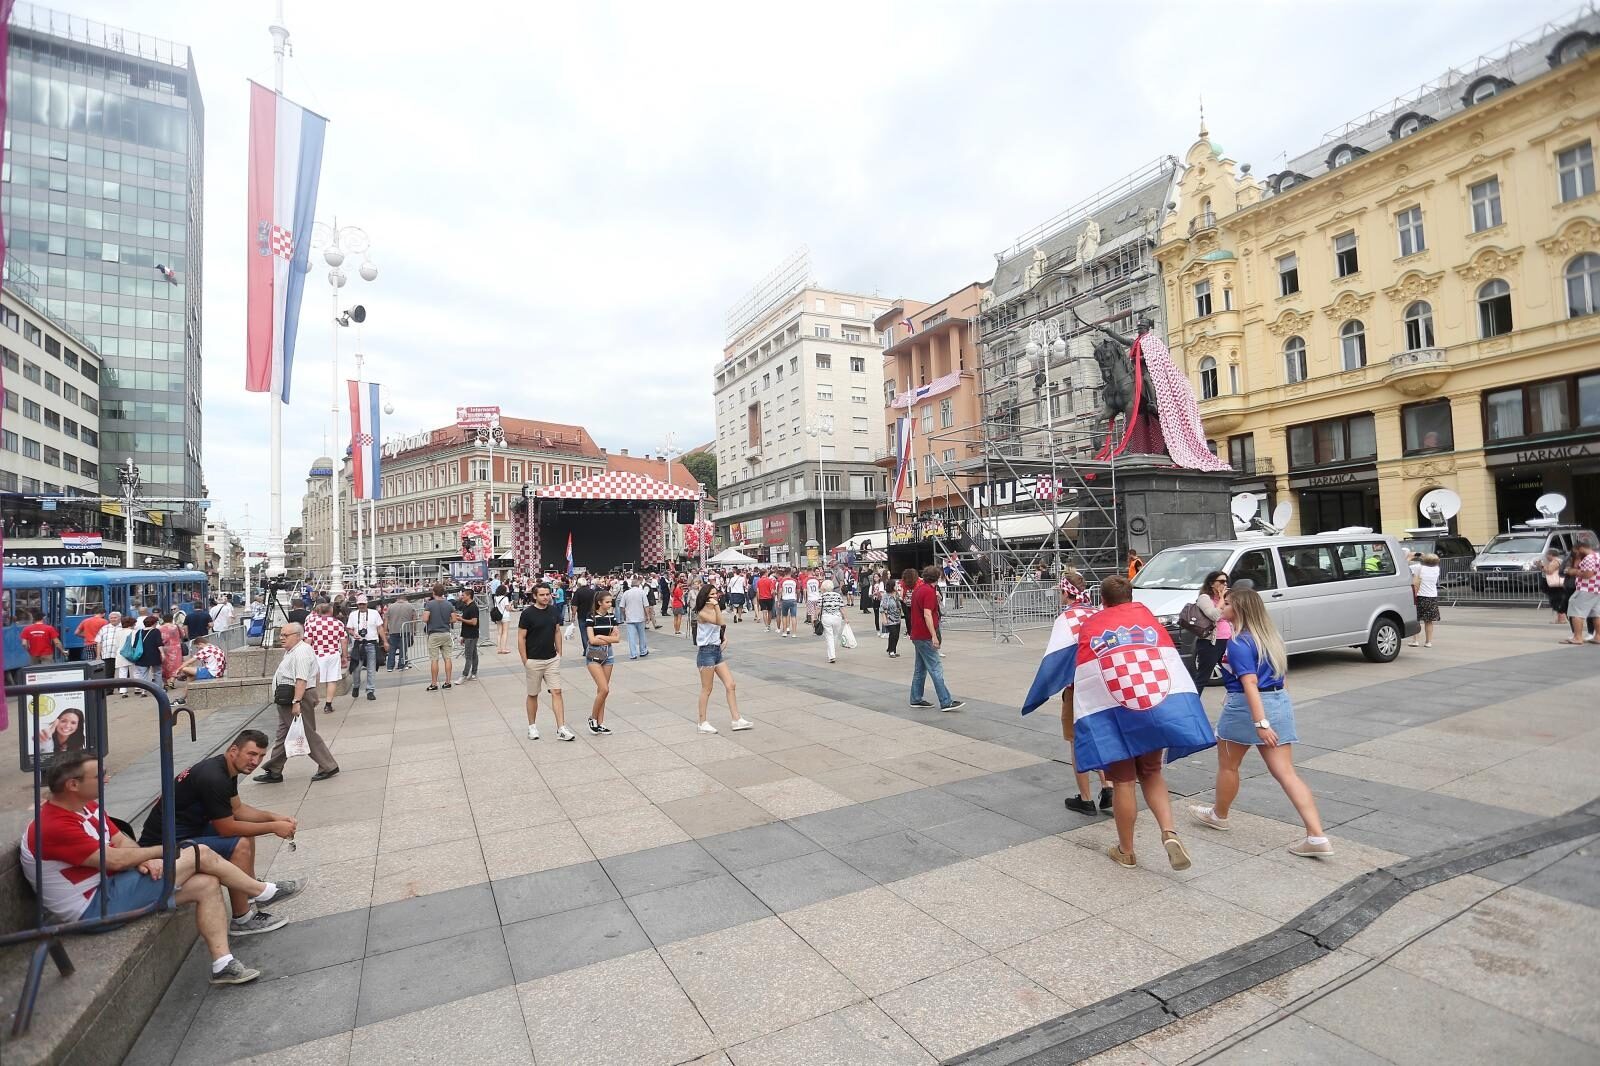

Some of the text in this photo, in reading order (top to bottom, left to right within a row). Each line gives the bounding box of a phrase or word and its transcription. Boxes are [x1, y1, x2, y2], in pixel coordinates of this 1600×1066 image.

[1517, 445, 1592, 462] HARMICA
[1309, 472, 1357, 486] HARMICA
[785, 586, 792, 594] 10
